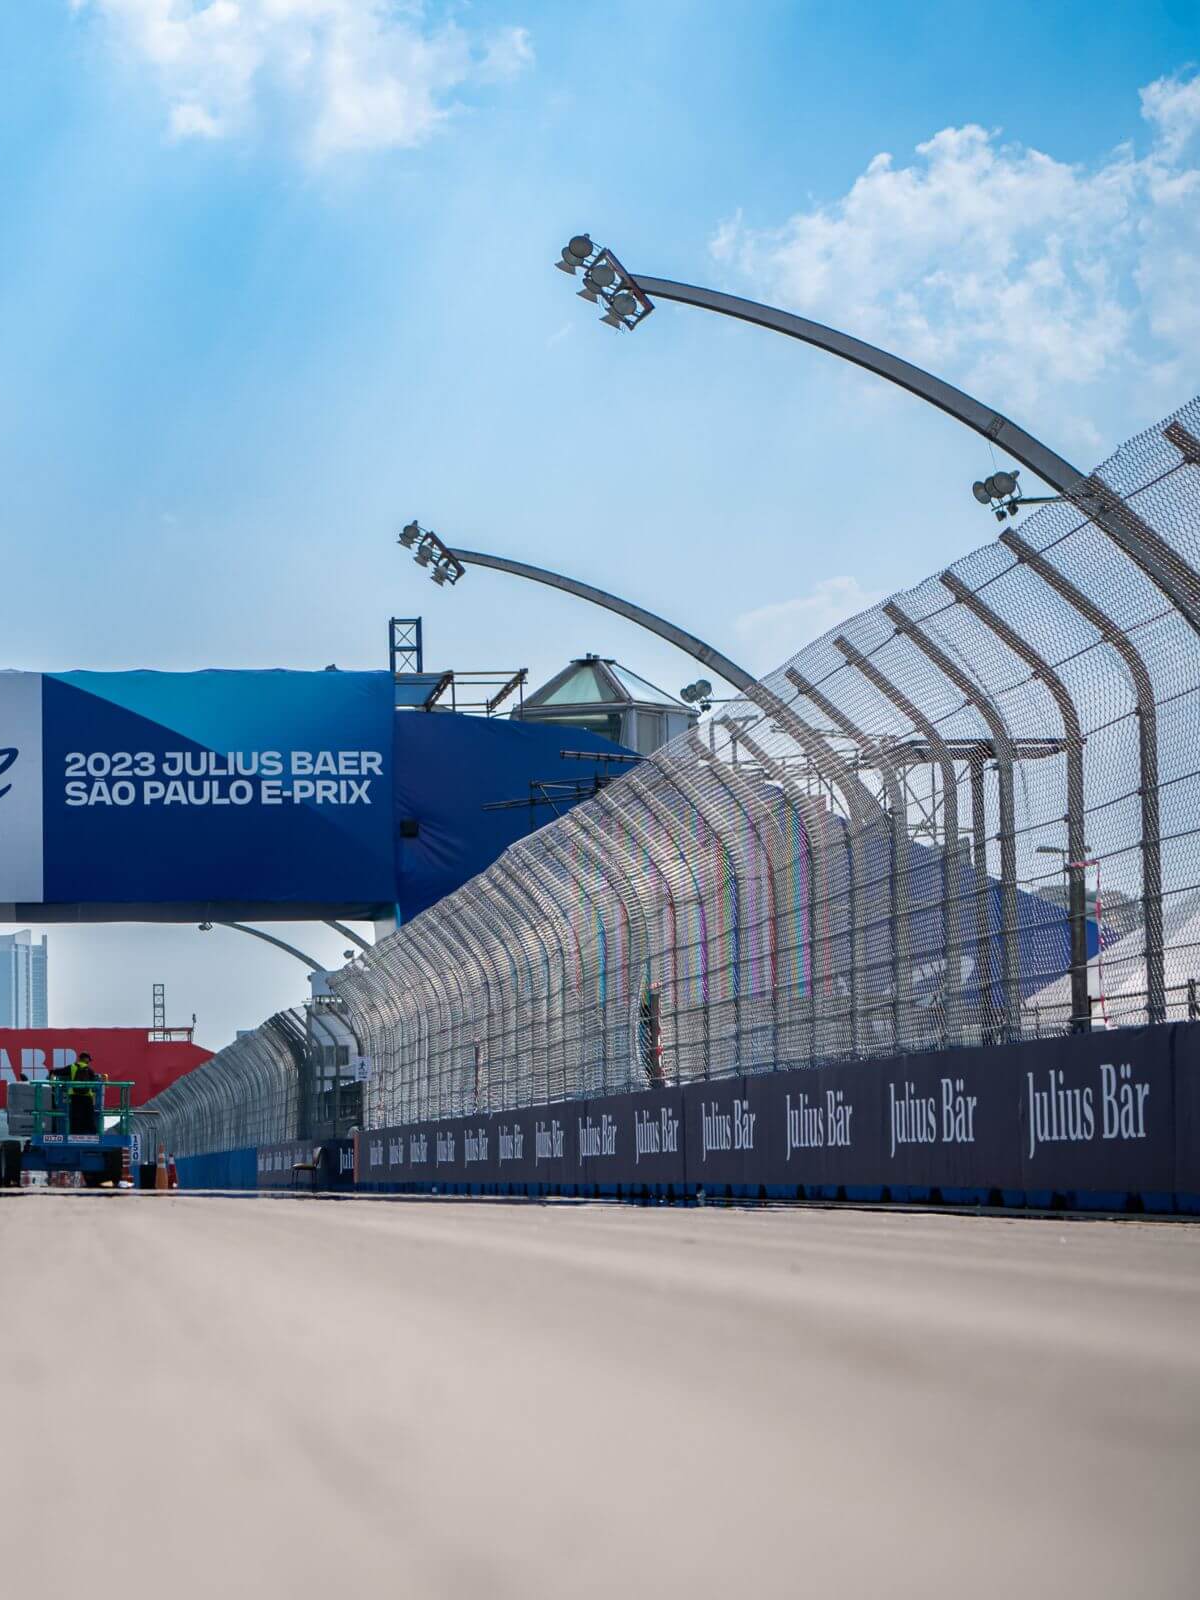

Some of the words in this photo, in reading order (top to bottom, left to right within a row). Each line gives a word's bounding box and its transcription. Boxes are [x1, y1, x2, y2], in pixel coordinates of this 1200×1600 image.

[65, 752, 155, 777] 2023
[162, 751, 283, 776] JULIUS
[291, 751, 383, 775] BAER
[65, 778, 136, 806] SÃO
[143, 780, 253, 805] PAULO
[261, 780, 372, 804] E-PRIX
[634, 1109, 660, 1164] Julius
[660, 1107, 679, 1152] Bär
[701, 1101, 732, 1162] Julius
[733, 1099, 756, 1150] Bär
[786, 1093, 824, 1161] Julius
[826, 1090, 853, 1147] Bär
[889, 1081, 937, 1159] Julius
[940, 1078, 977, 1143] Bär
[1027, 1069, 1095, 1160] Julius
[1100, 1063, 1150, 1139] Bär
